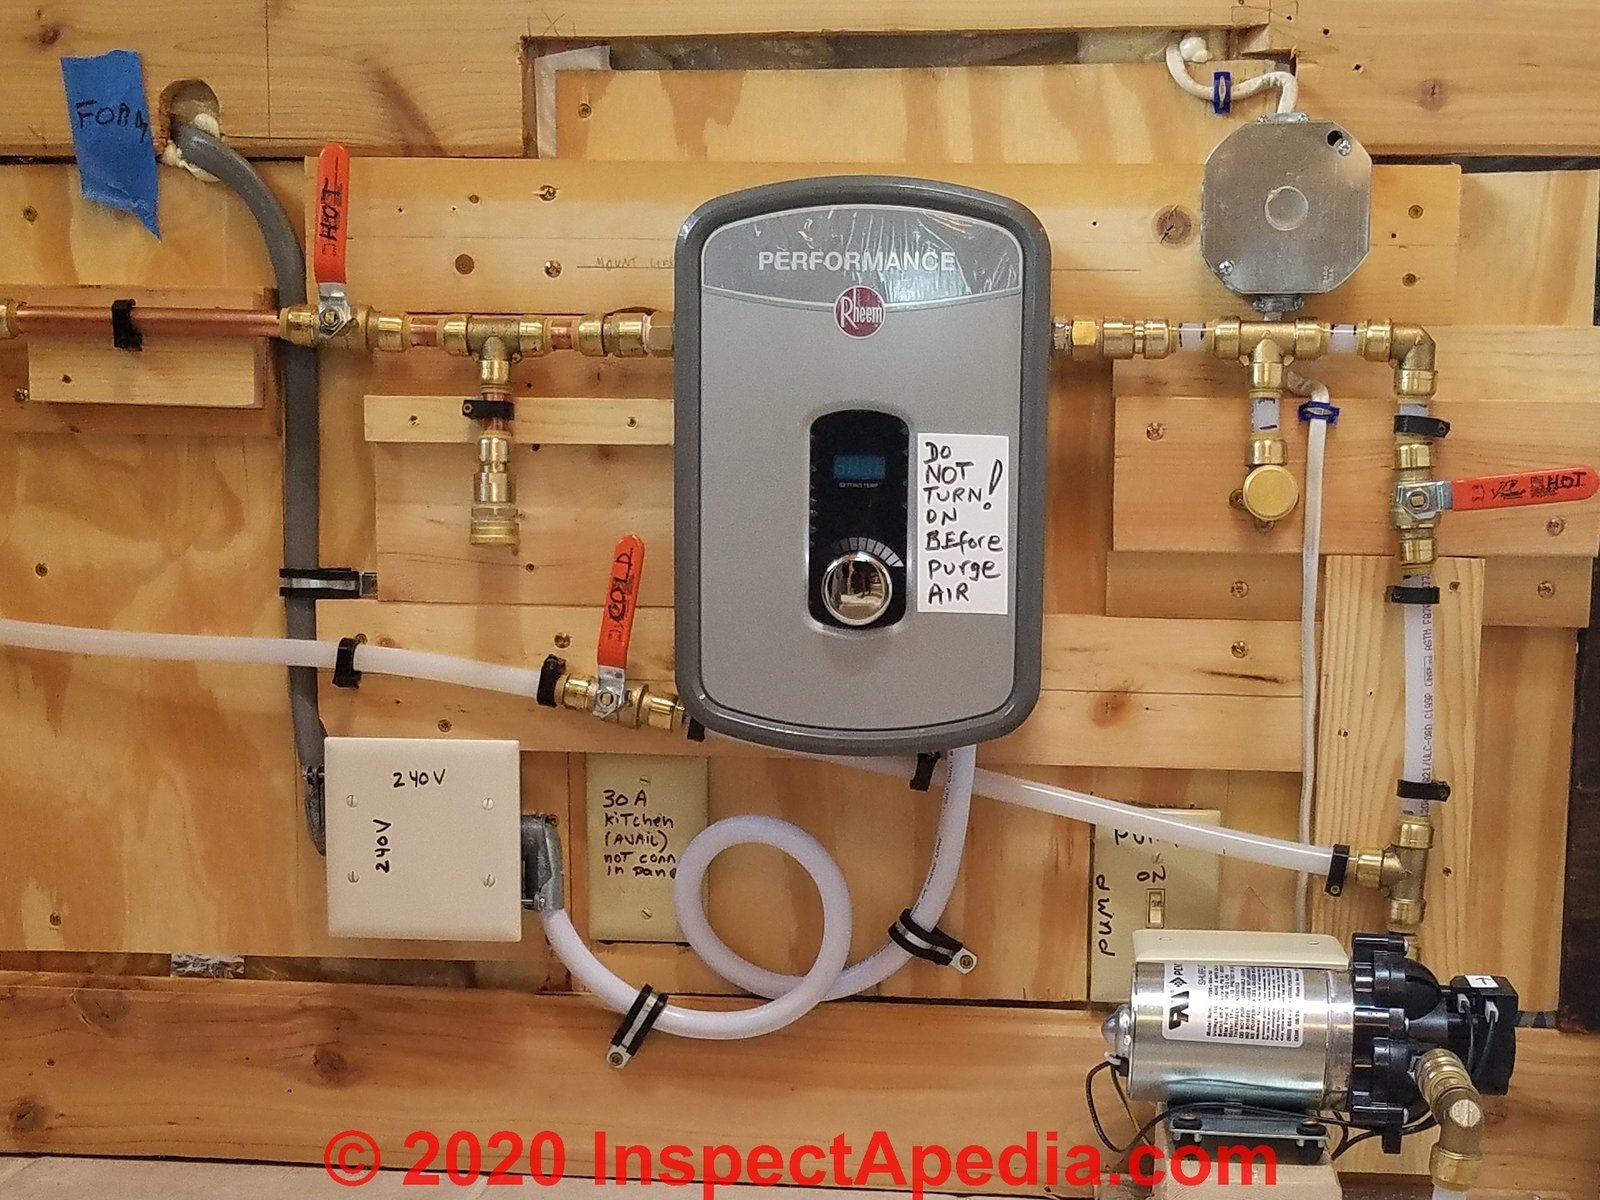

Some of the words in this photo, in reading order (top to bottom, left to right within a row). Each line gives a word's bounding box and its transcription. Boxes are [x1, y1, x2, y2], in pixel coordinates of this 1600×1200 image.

[758, 251, 956, 271] PERFORMANCE
[840, 288, 882, 329] Rheem
[924, 442, 952, 463] DO
[925, 461, 975, 485] NOT
[1546, 471, 1587, 494] HOT
[926, 507, 957, 526] ON
[608, 547, 634, 622] COLD
[928, 582, 969, 605] AIR
[373, 819, 391, 873] 240V
